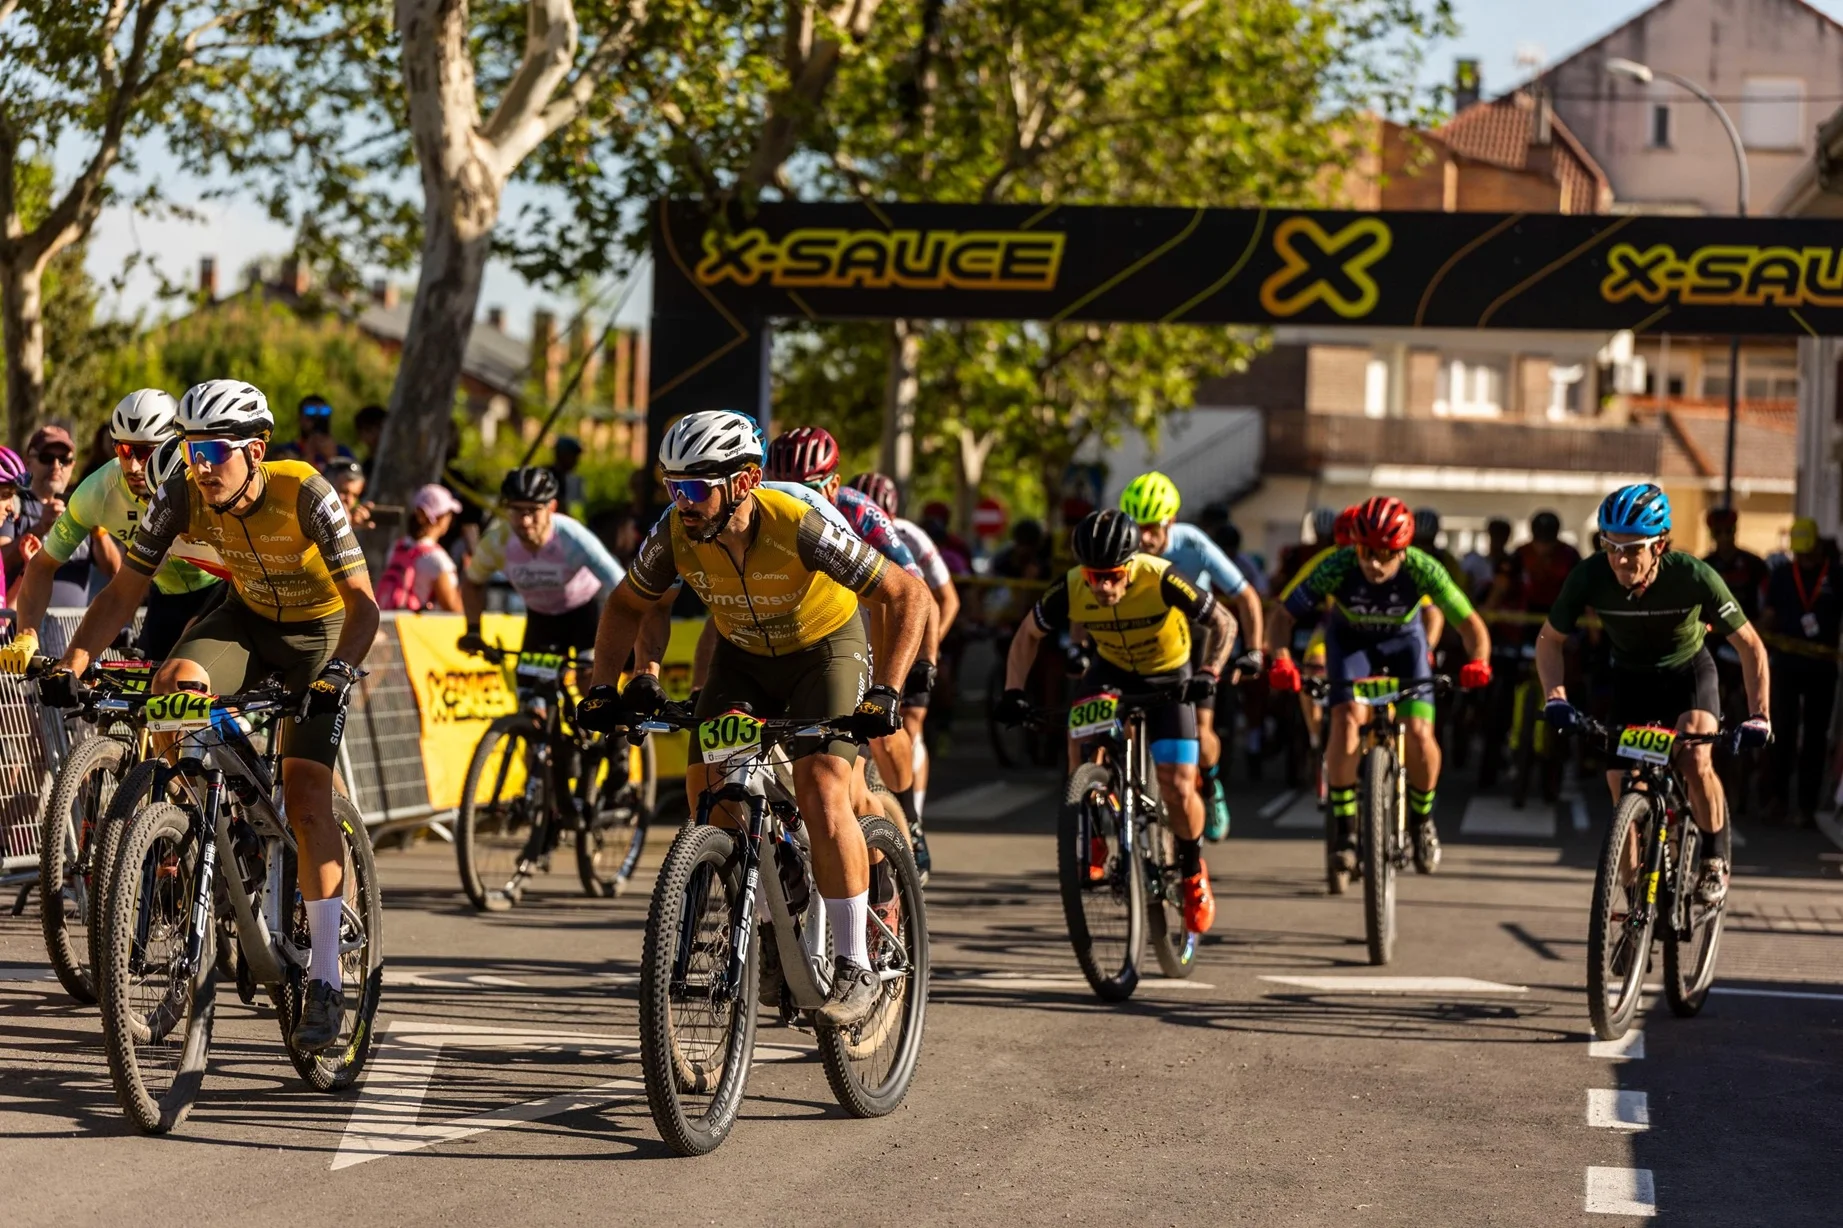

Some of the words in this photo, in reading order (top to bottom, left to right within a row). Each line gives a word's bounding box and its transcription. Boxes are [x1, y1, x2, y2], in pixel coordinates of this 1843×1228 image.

[696, 228, 1066, 290] X-SAUCE
[764, 573, 789, 581] ATIKA
[150, 693, 207, 720] 304
[1072, 700, 1112, 726] 308
[703, 715, 758, 749] 303
[1623, 730, 1670, 753] 309
[707, 998, 748, 1127] BONTRAGER
